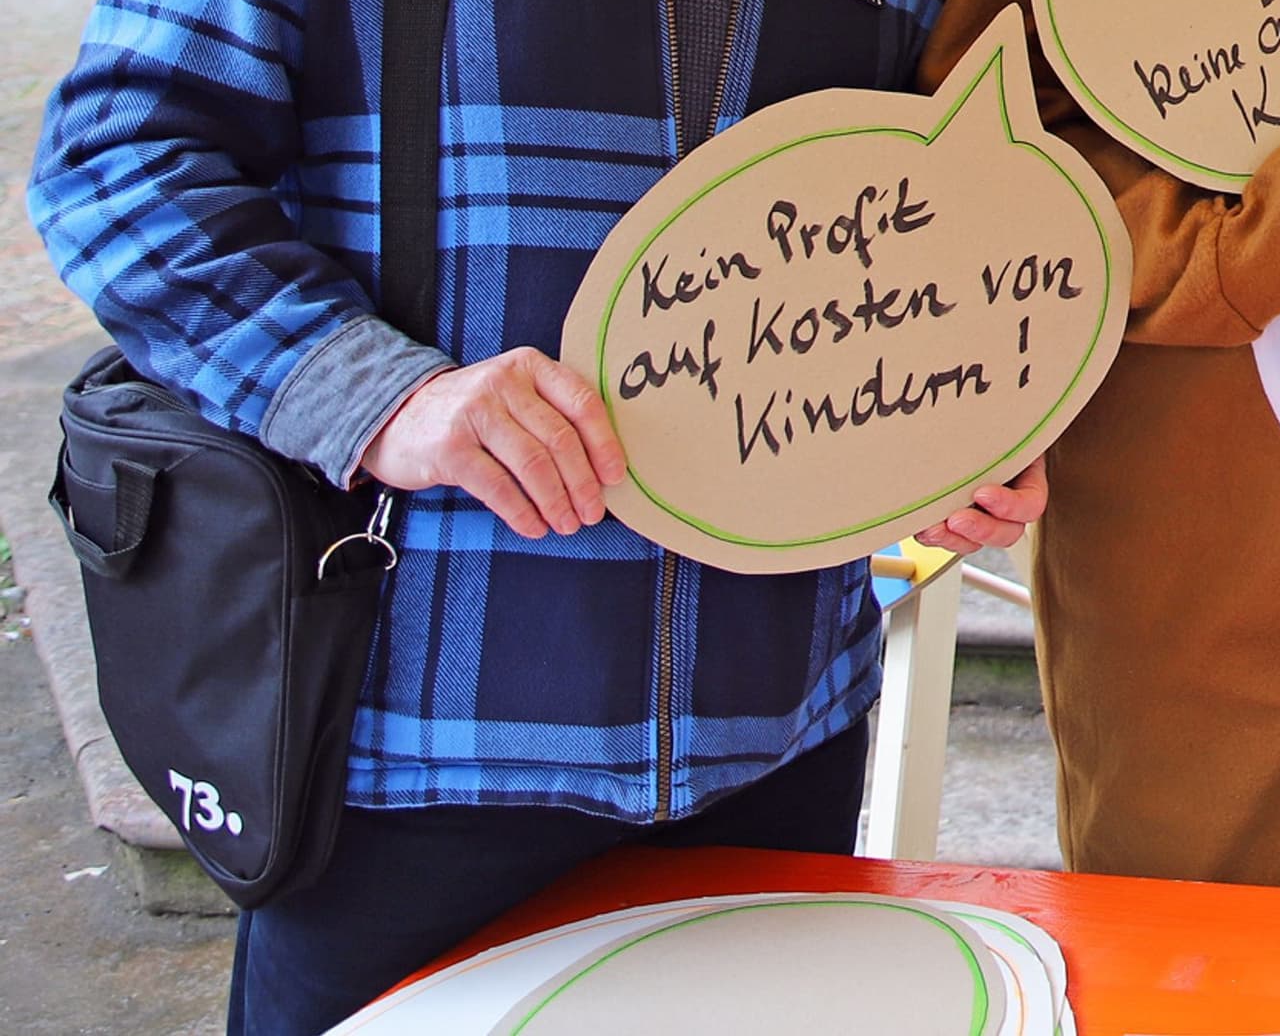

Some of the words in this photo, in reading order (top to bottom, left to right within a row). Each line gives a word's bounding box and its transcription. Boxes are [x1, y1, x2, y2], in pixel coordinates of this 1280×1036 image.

[641, 248, 761, 318] Kein
[766, 177, 936, 268] Profit
[619, 320, 722, 401] auf
[747, 278, 959, 364] Kosten
[981, 254, 1084, 305] von
[734, 357, 991, 465] Kindern
